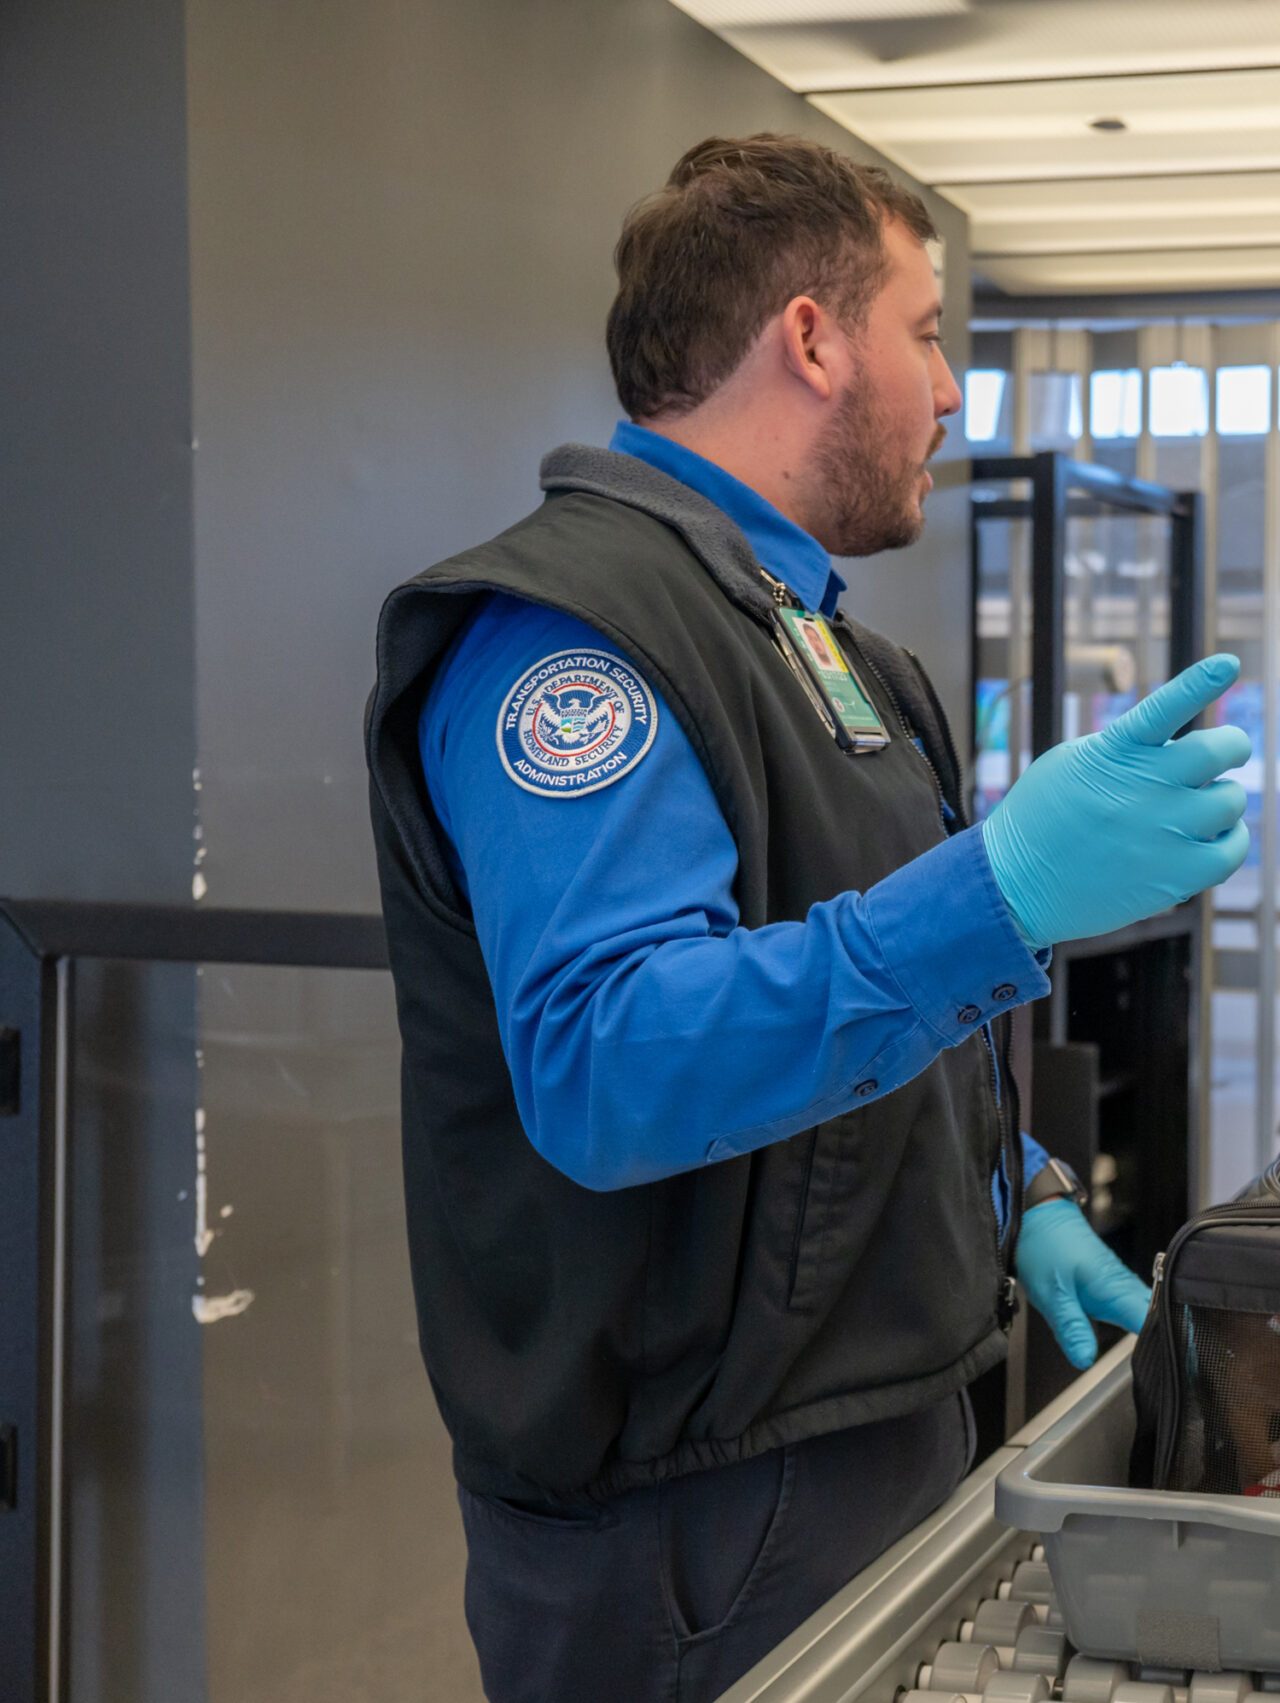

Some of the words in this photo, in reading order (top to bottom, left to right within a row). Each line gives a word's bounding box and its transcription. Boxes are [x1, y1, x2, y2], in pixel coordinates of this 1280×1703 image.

[506, 657, 611, 730] TRANSPORTATION
[609, 667, 648, 725] SECURITY
[545, 674, 619, 700] DEPARTMENT
[613, 700, 625, 714] OF
[523, 729, 570, 767] HOMELAND
[574, 725, 624, 766] SECURITY
[513, 751, 628, 787] ADMINISTRATION
